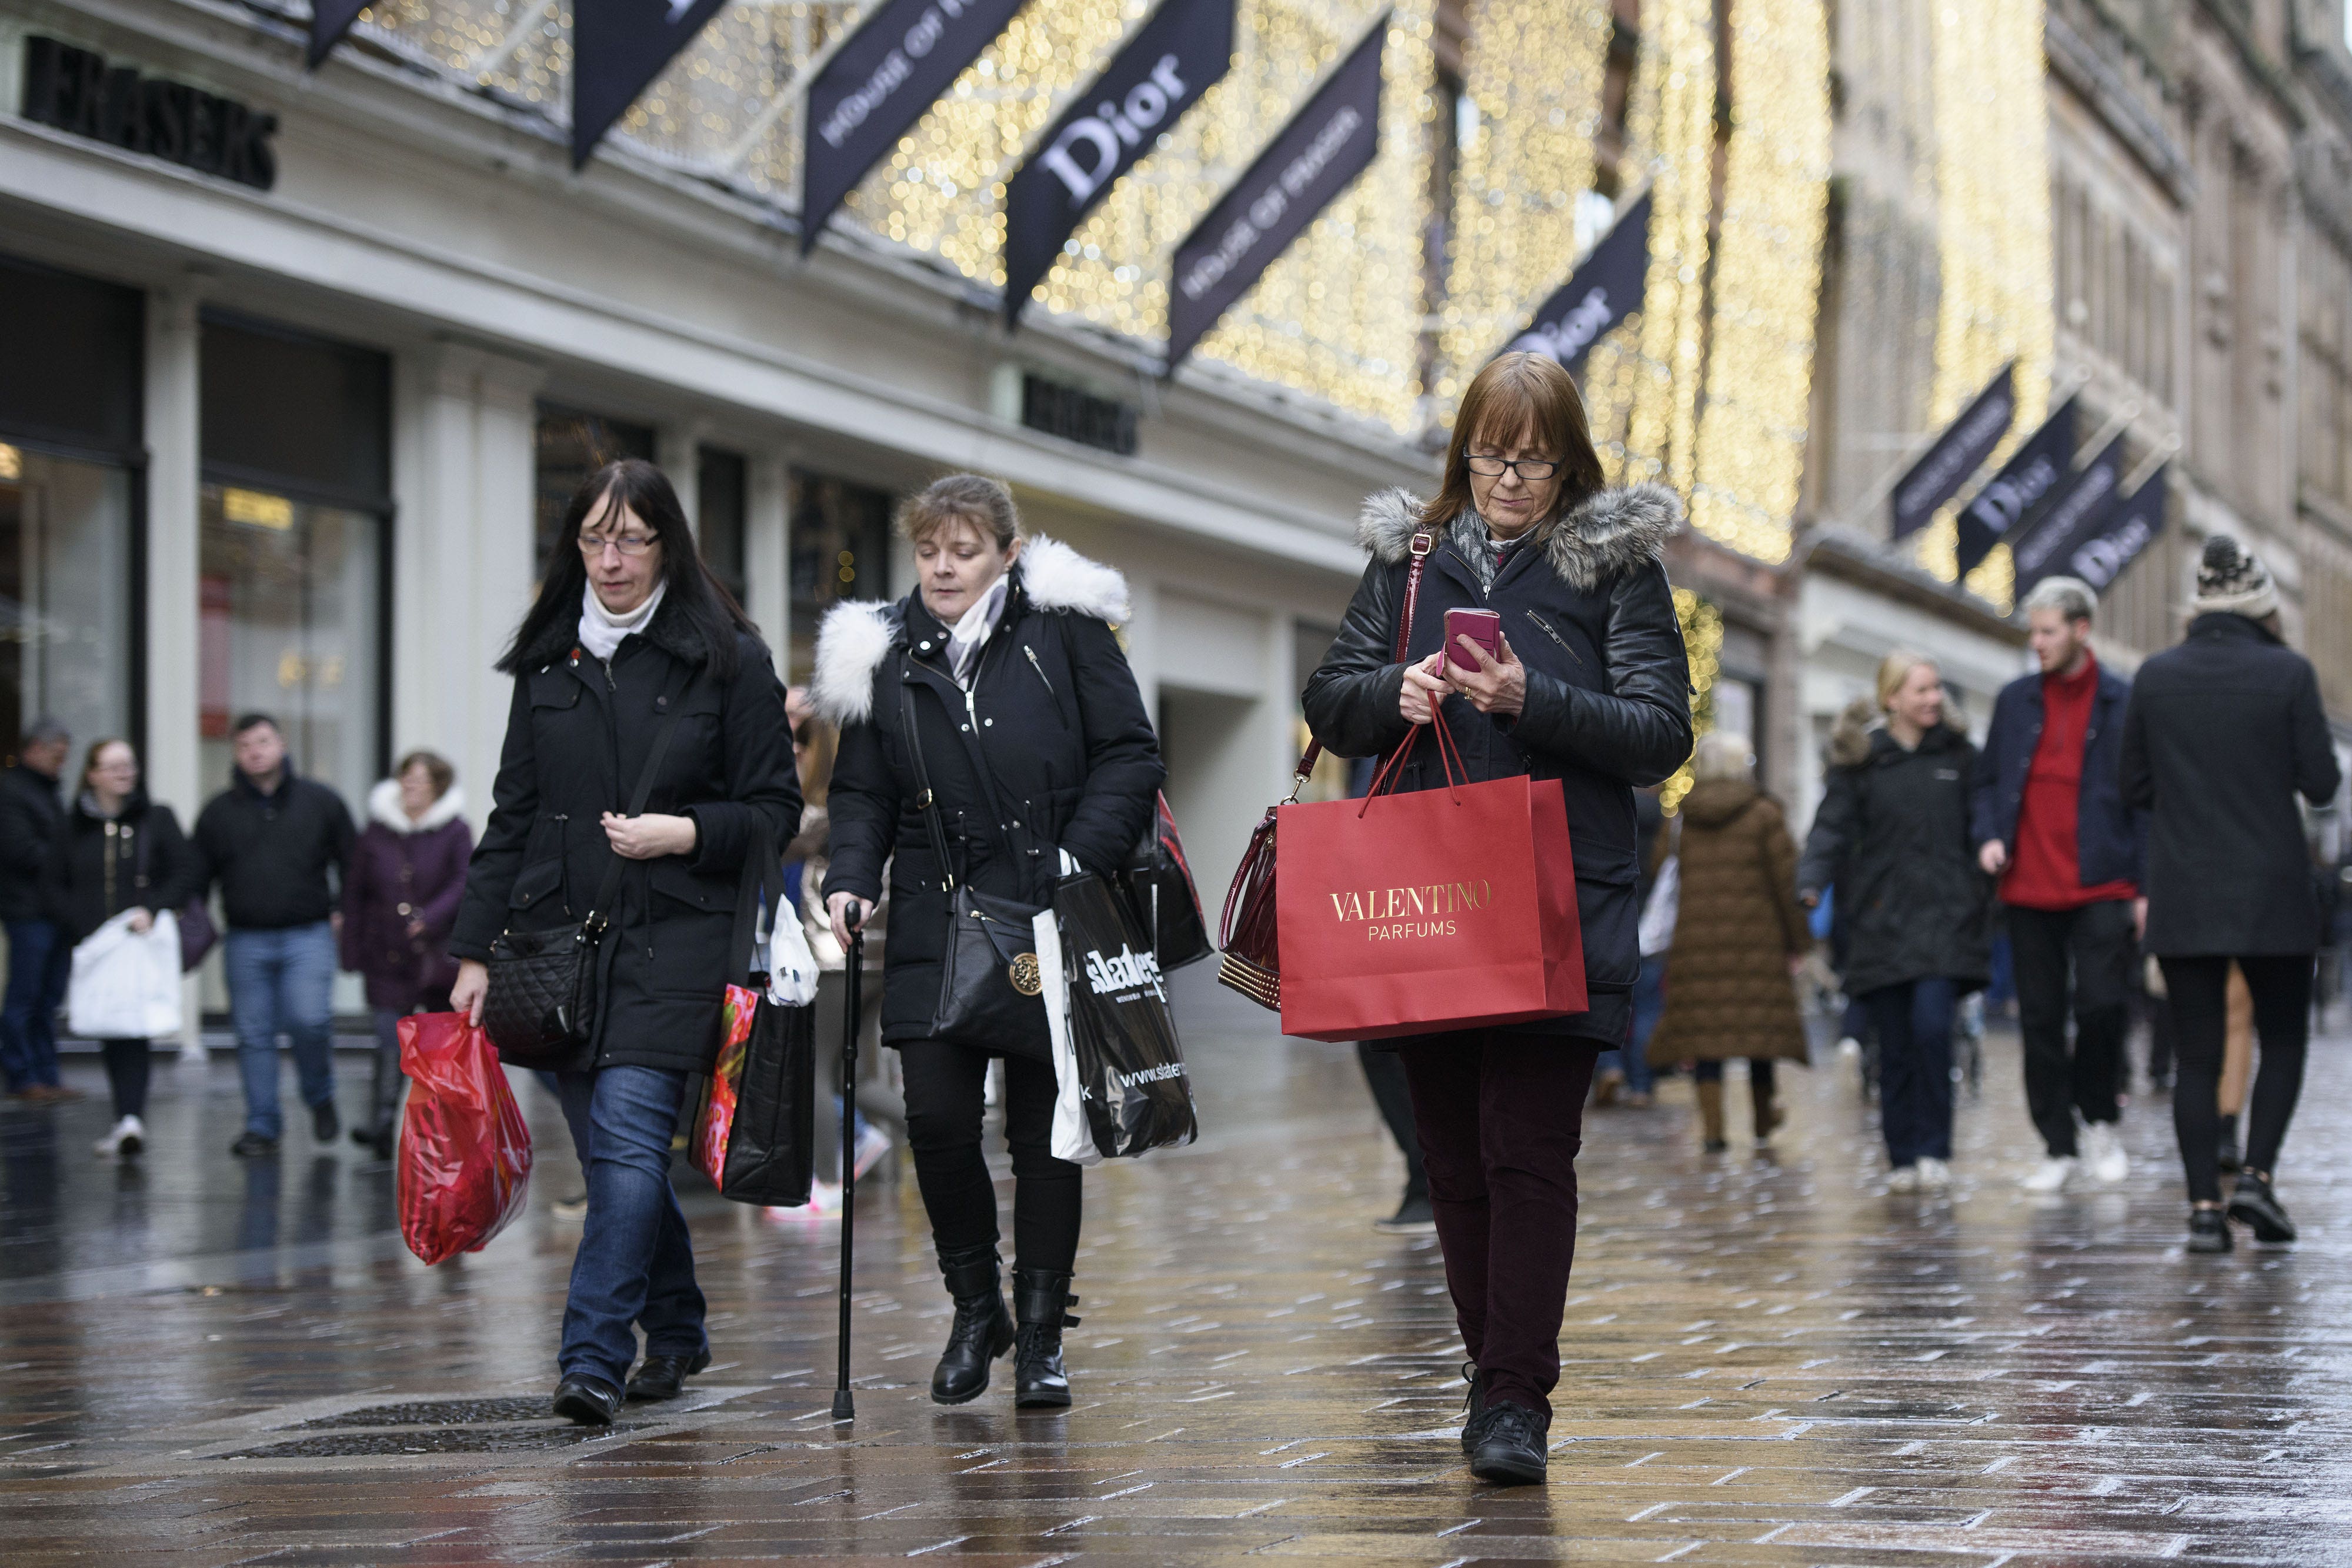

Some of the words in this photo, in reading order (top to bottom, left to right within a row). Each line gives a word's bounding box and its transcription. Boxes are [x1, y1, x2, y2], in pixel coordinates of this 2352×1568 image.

[1035, 53, 1187, 208] Dior
[1329, 879, 1492, 922] VALENTINO
[1369, 920, 1456, 941] PARFUMS
